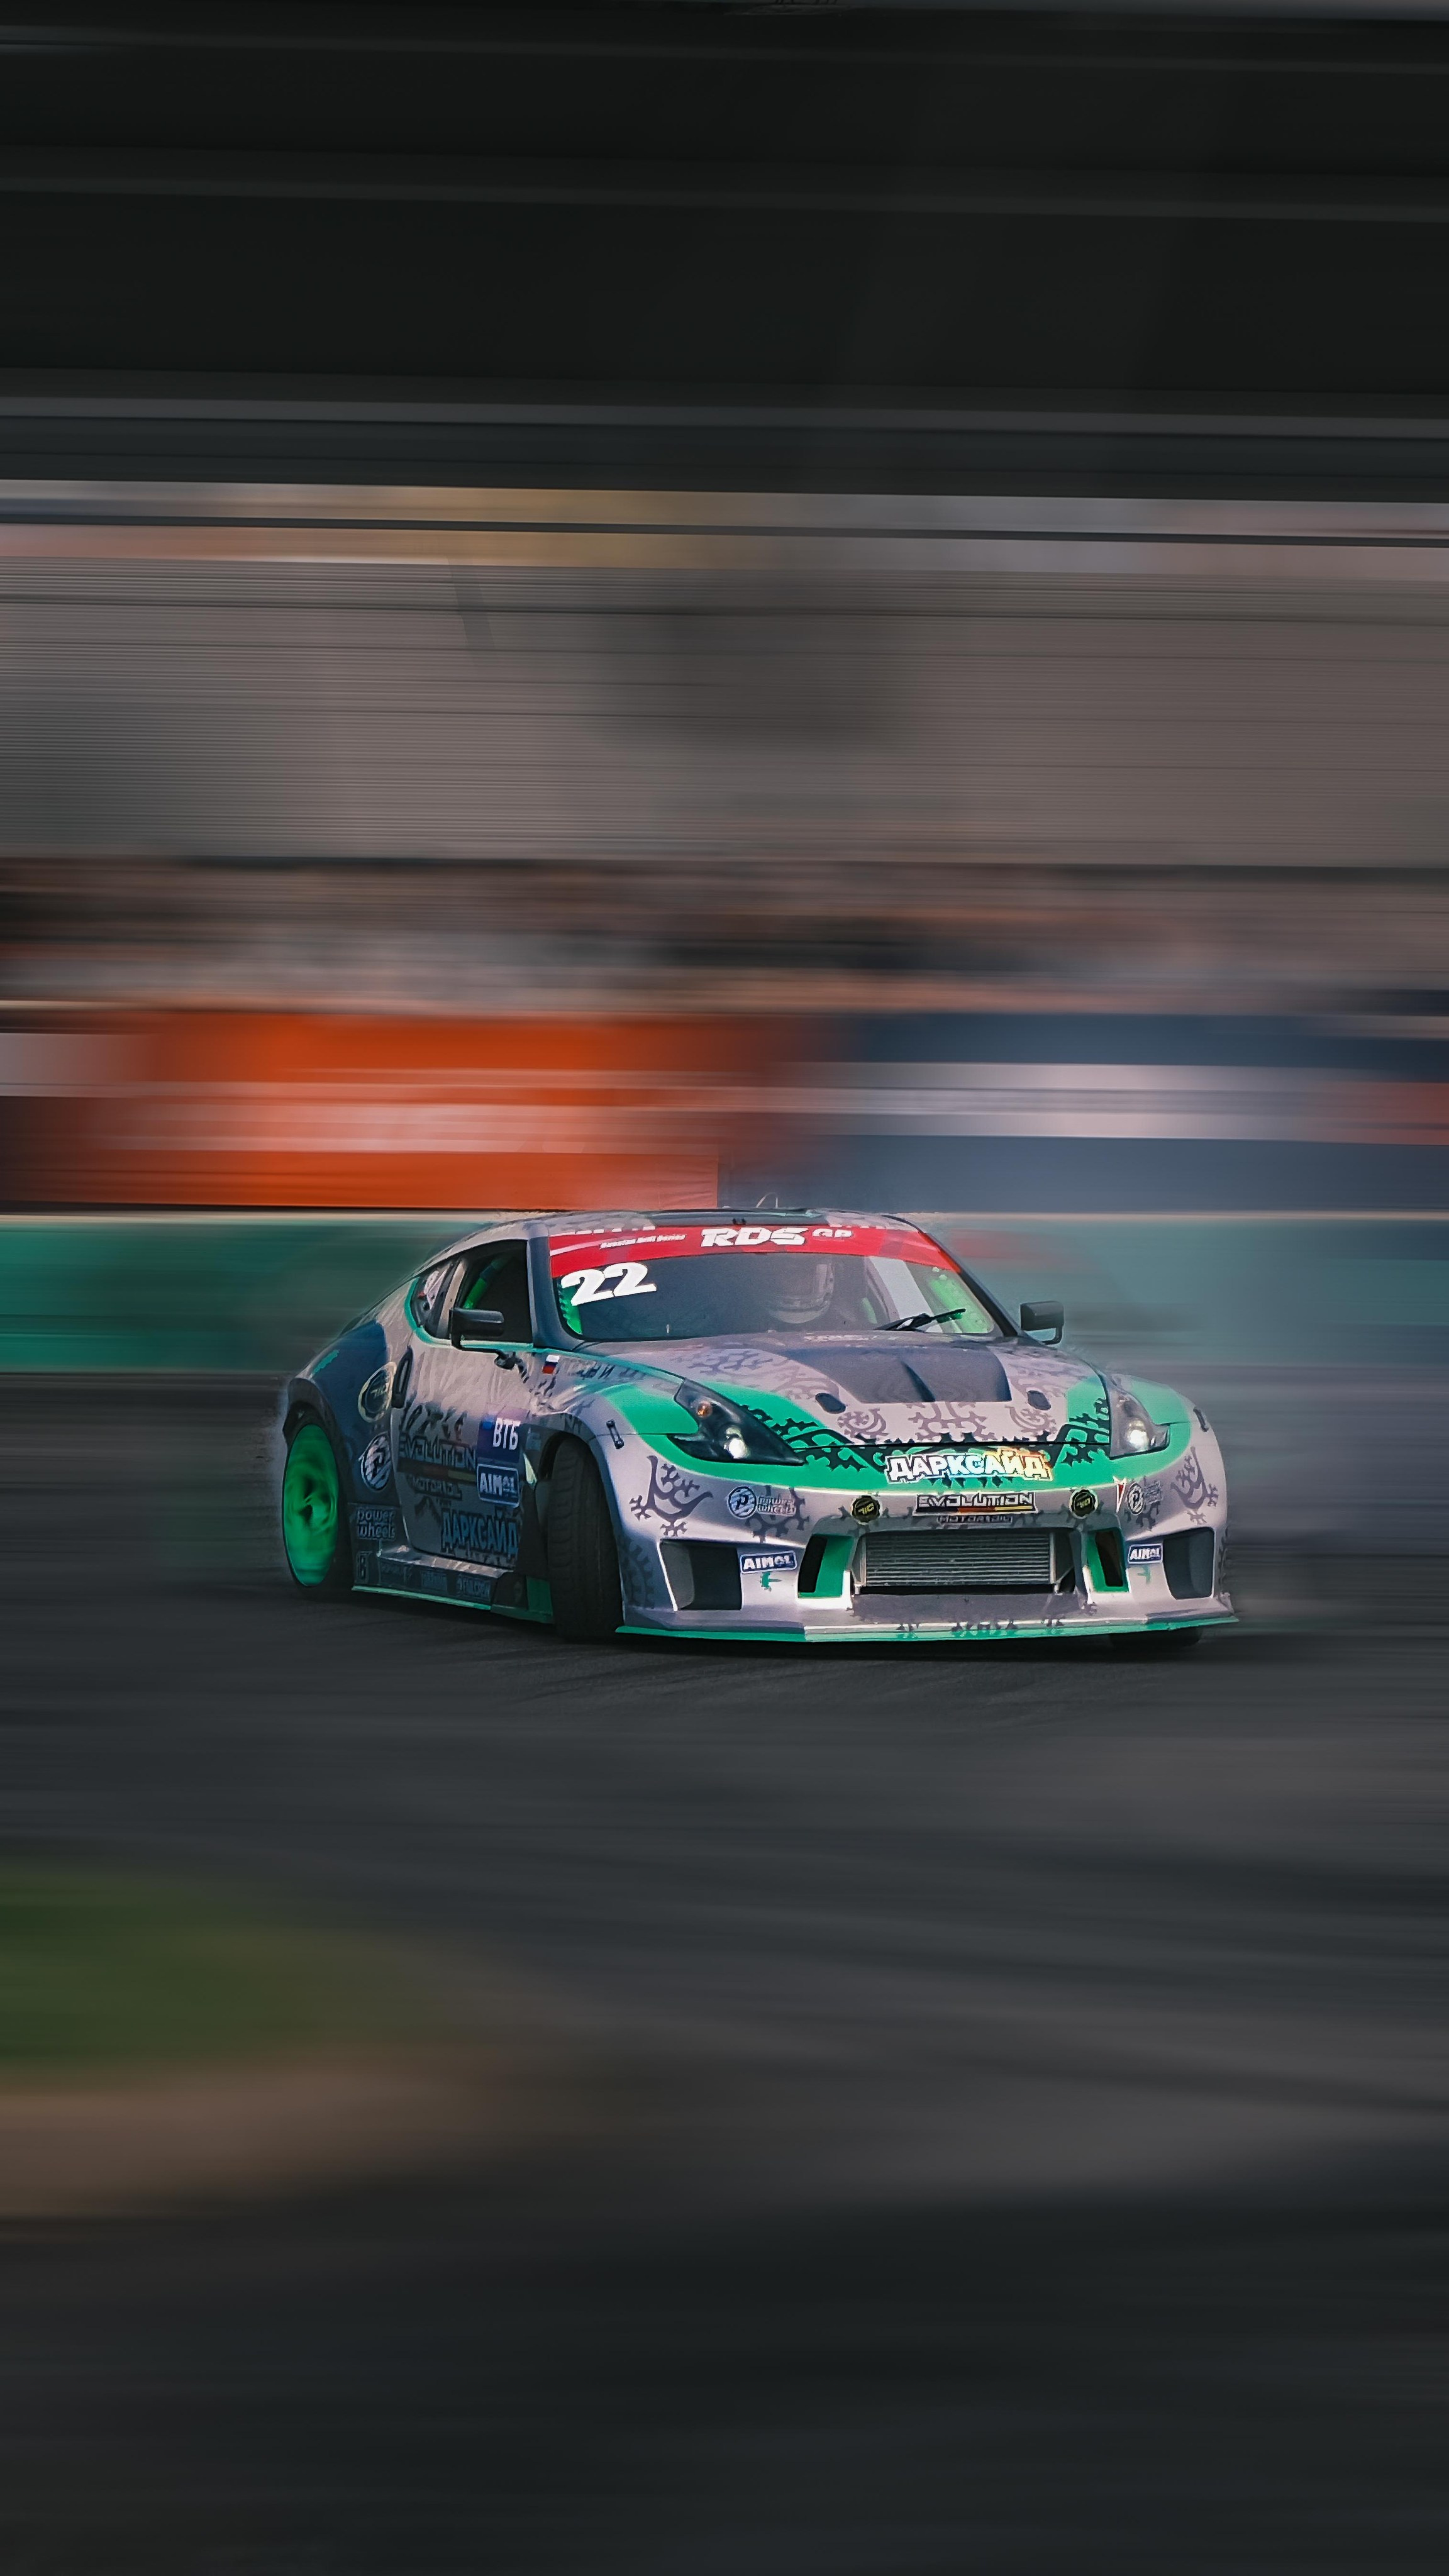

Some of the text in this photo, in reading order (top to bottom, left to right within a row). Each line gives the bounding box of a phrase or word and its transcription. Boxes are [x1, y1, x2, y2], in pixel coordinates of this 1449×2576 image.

[701, 1227, 809, 1247] RDS
[561, 1262, 657, 1306] 22
[492, 1418, 521, 1450] ВТБ
[887, 1450, 1052, 1482] ДАРКСАЙД
[918, 1493, 1033, 1507] EVOLUTION
[441, 1508, 519, 1561] ДАРКСАЙД
